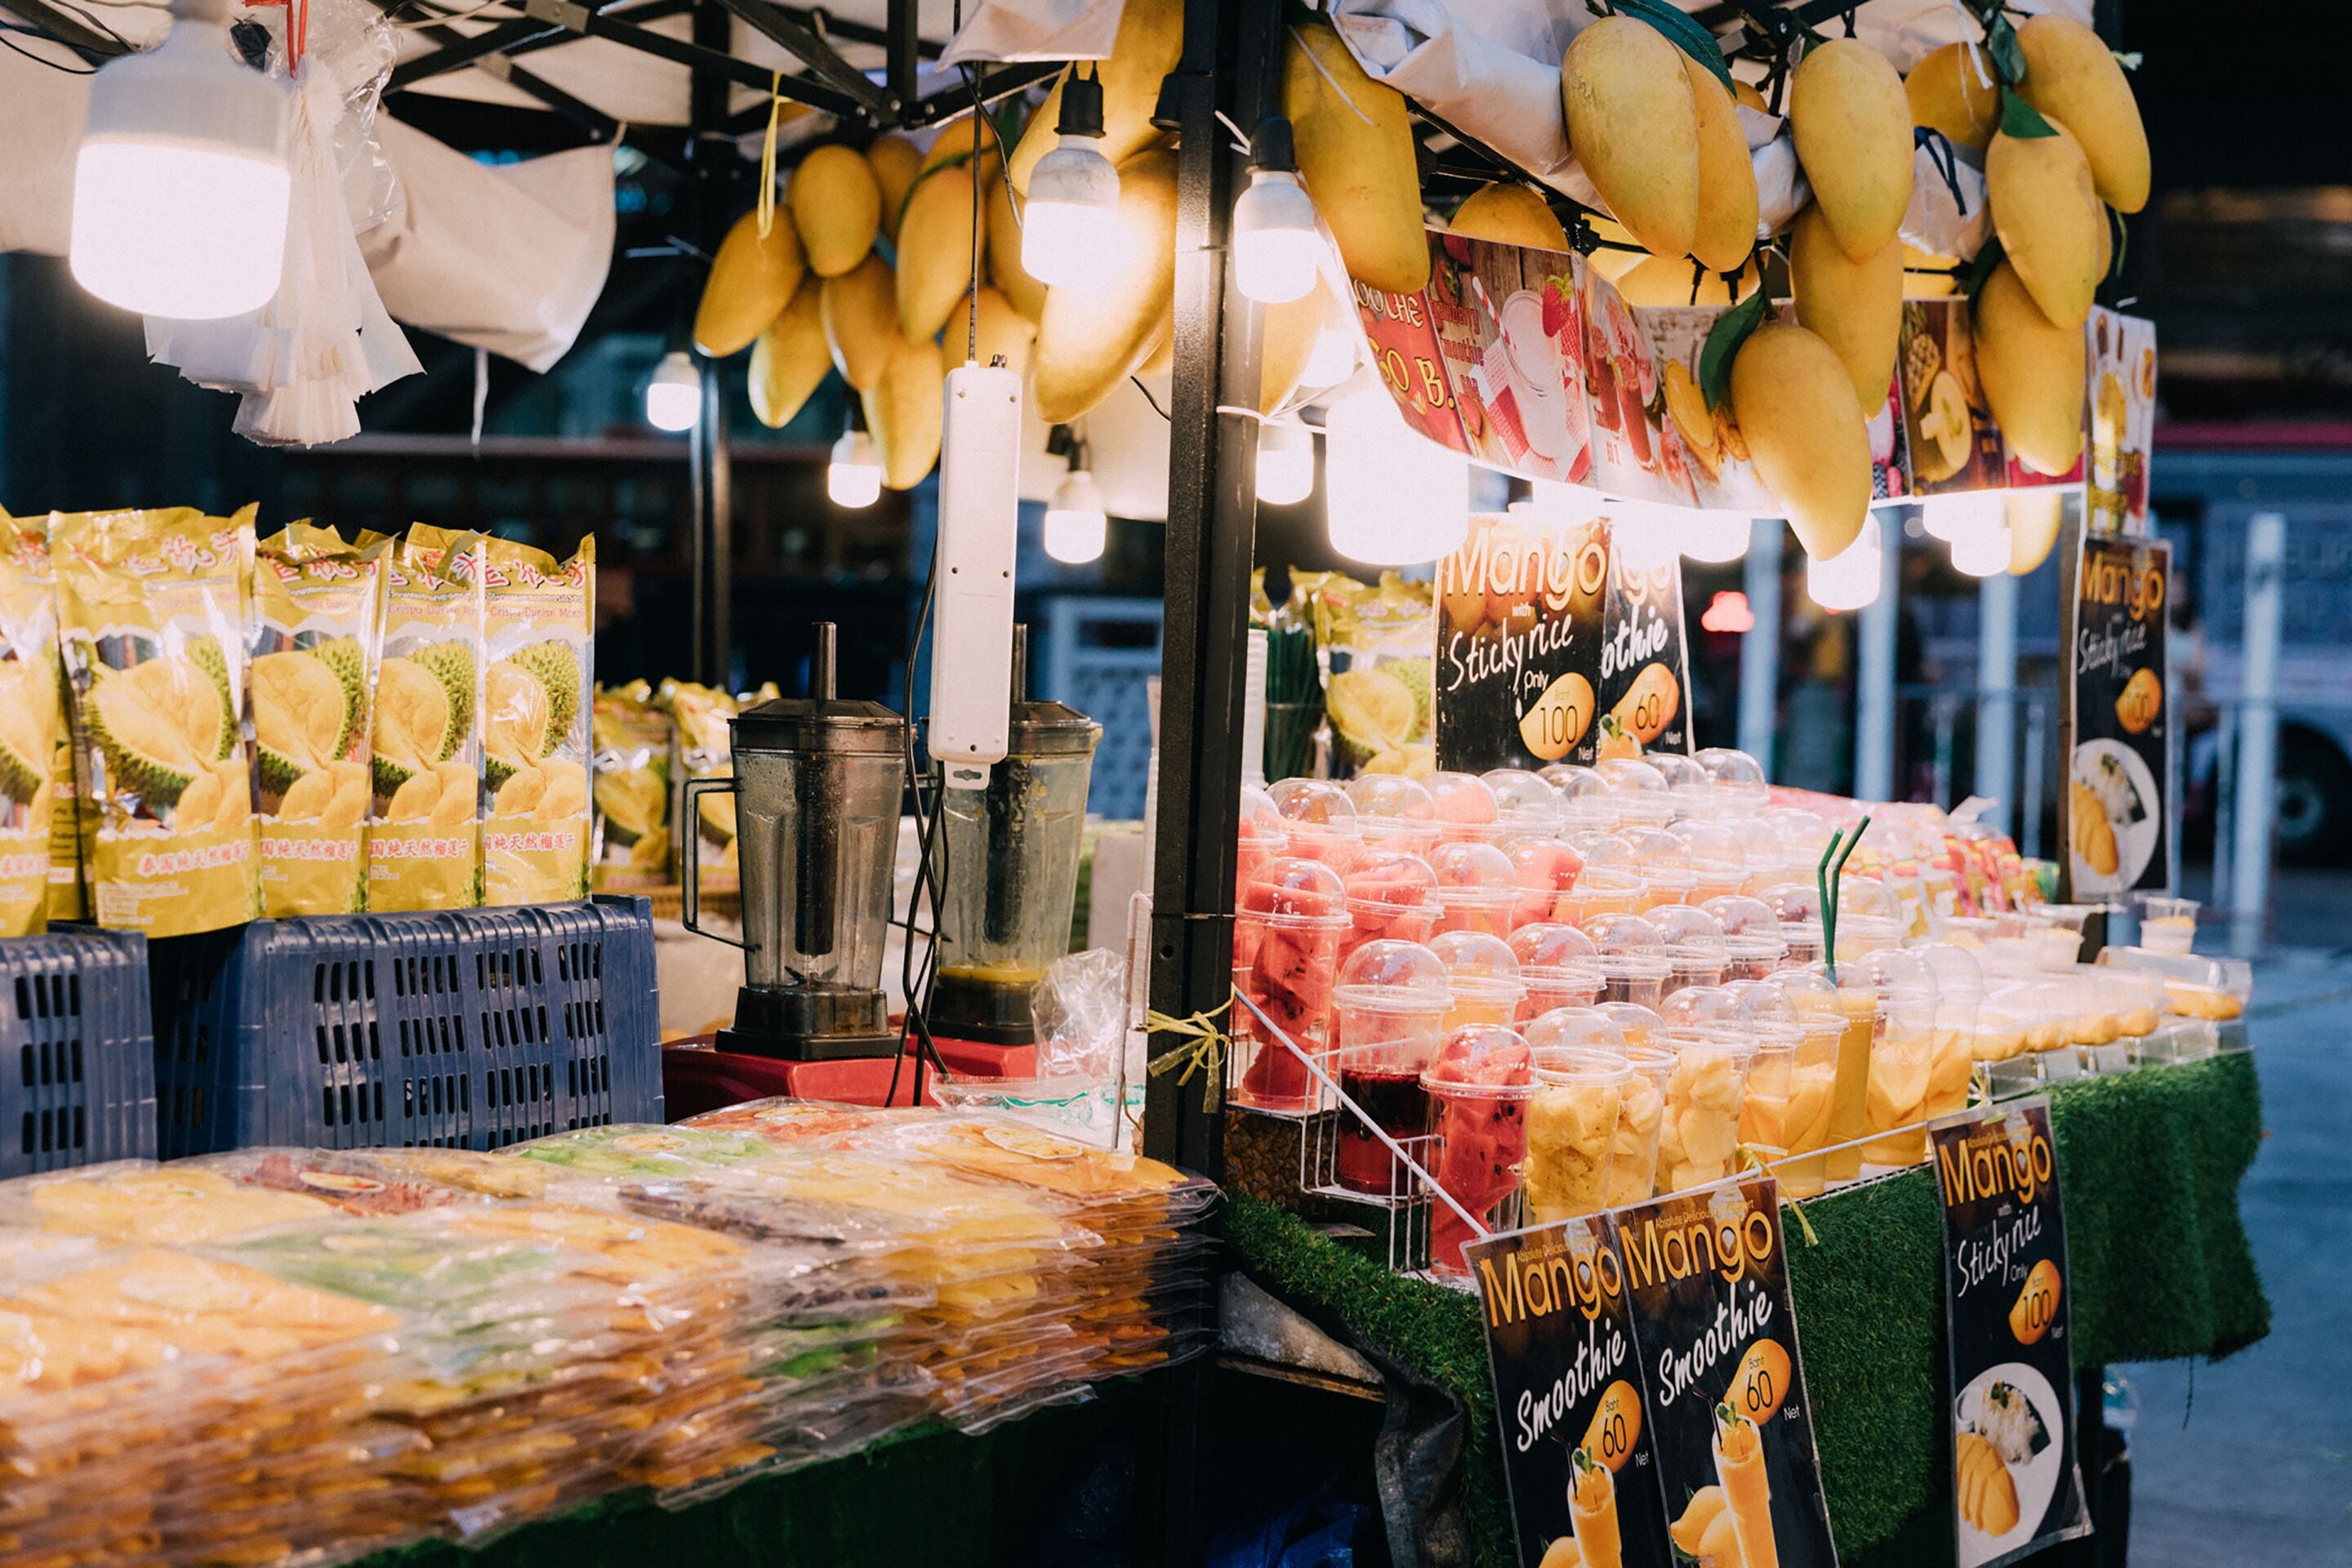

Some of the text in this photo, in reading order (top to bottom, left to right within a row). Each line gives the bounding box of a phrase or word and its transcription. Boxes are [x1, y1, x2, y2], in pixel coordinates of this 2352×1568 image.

[1444, 525, 1601, 612] Mango
[2079, 548, 2164, 621] Mango
[1512, 602, 1532, 617] with
[1601, 604, 1668, 679] othie
[1447, 612, 1575, 693] Sticky rice
[1524, 670, 1549, 700] Only
[1539, 705, 1594, 762] 100 Net
[1635, 693, 1659, 731] 60
[1939, 1135, 2051, 1207] Mango
[1481, 1245, 1622, 1328] Mango
[1619, 1210, 1774, 1290] Mango
[1958, 1205, 2042, 1298] Sticky rice
[1659, 1280, 1774, 1407] Smoothie
[2023, 1289, 2051, 1332] 100
[1517, 1317, 1627, 1452] Smoothie
[1746, 1370, 1802, 1422] 60 Net
[1602, 1413, 1650, 1468] 60 Net
